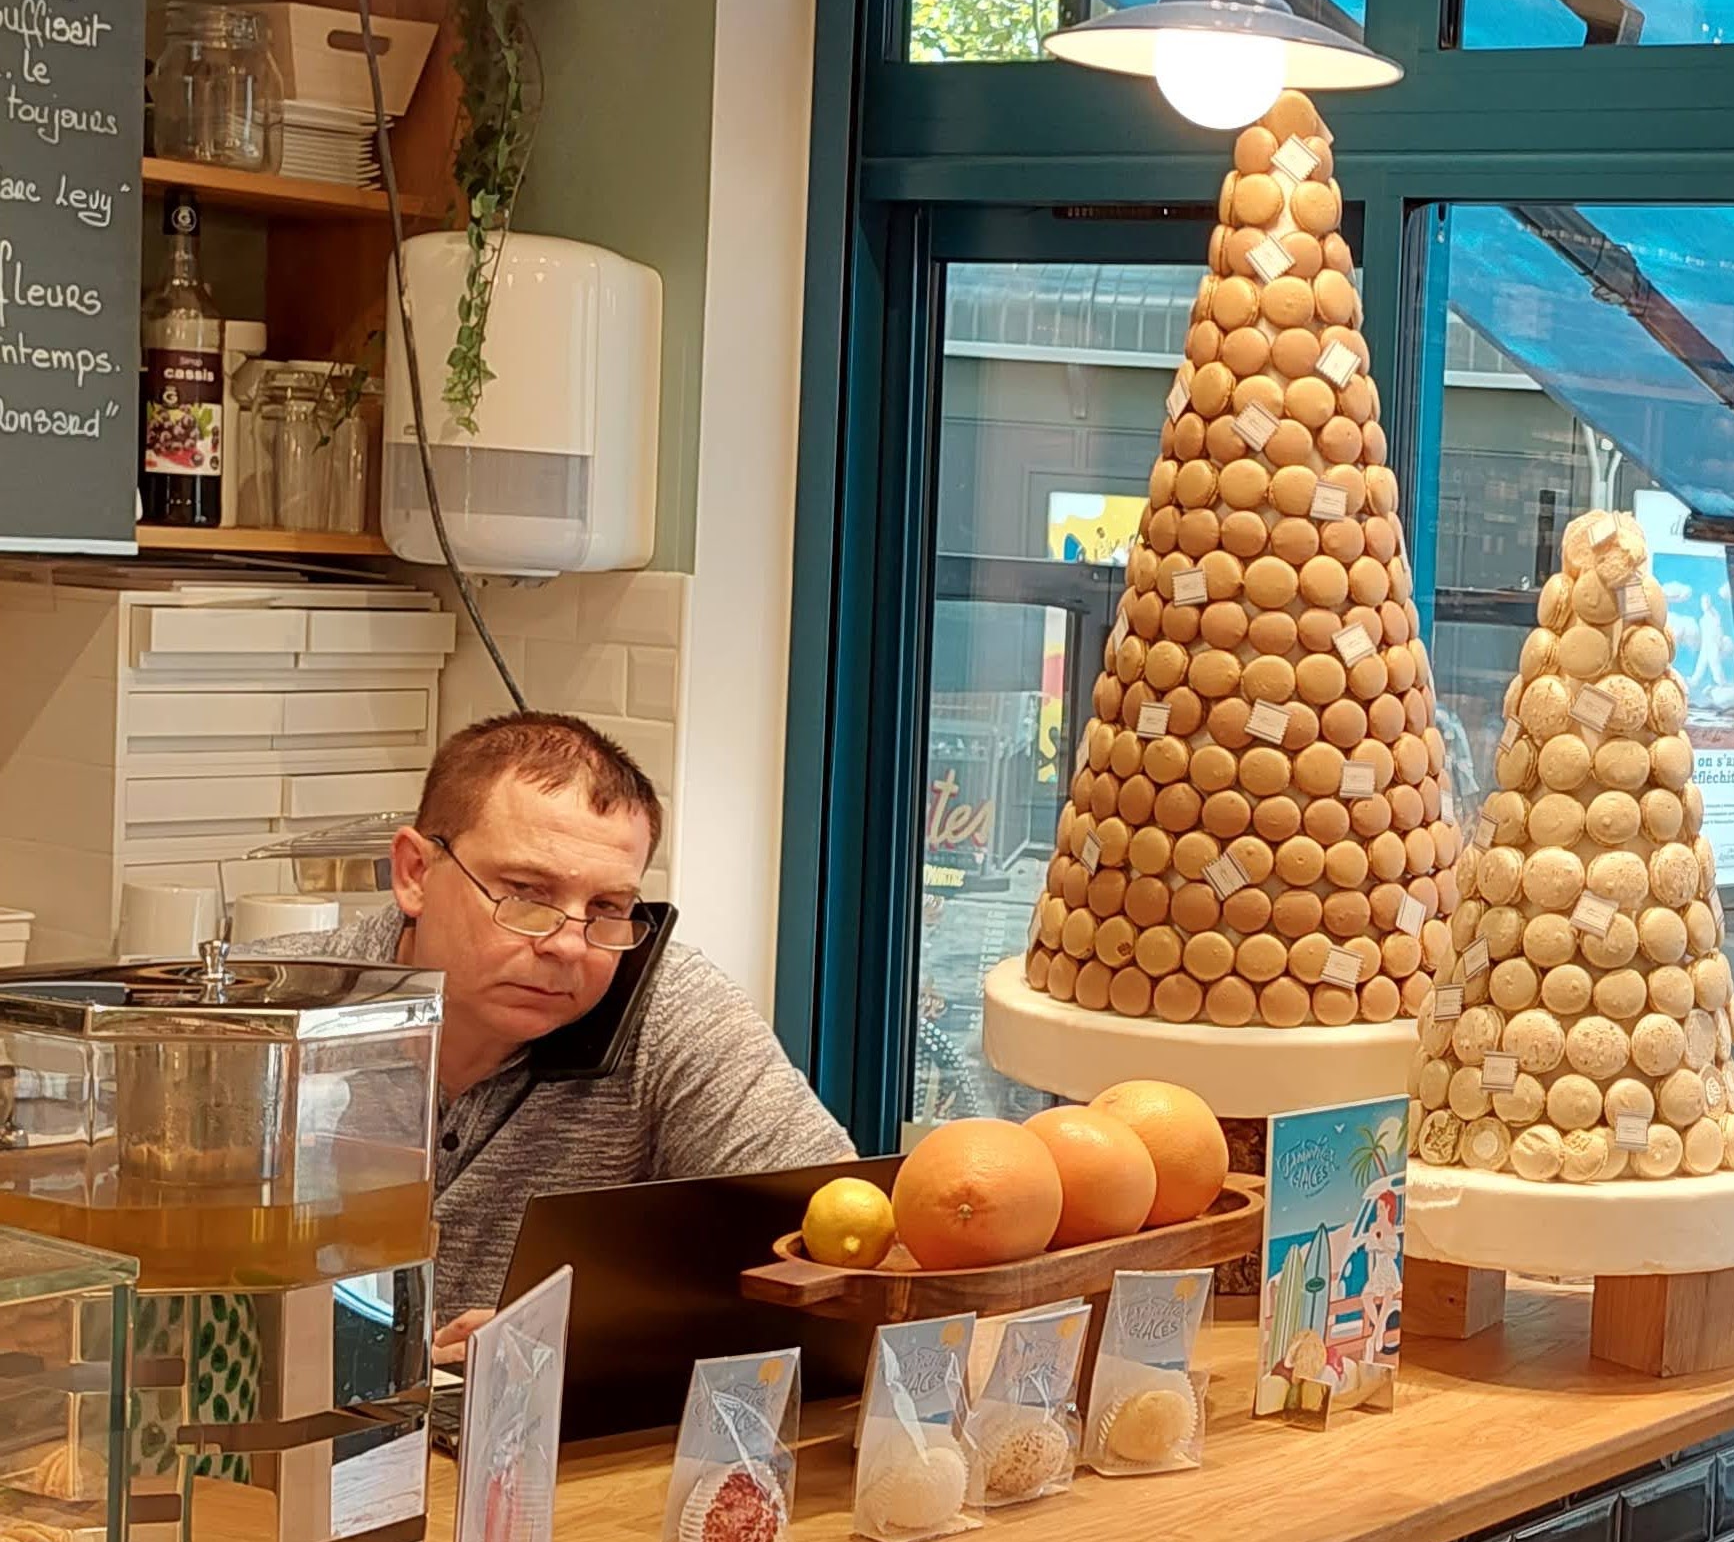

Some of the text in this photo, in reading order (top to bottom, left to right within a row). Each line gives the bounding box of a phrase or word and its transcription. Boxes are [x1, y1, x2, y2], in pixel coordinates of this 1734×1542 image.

[23, 48, 51, 84] le
[7, 84, 118, 145] toujours
[0, 332, 120, 387] ntemps.
[163, 368, 214, 382] cassis
[0, 399, 119, 438] onsard"
[1698, 755, 1713, 768] on
